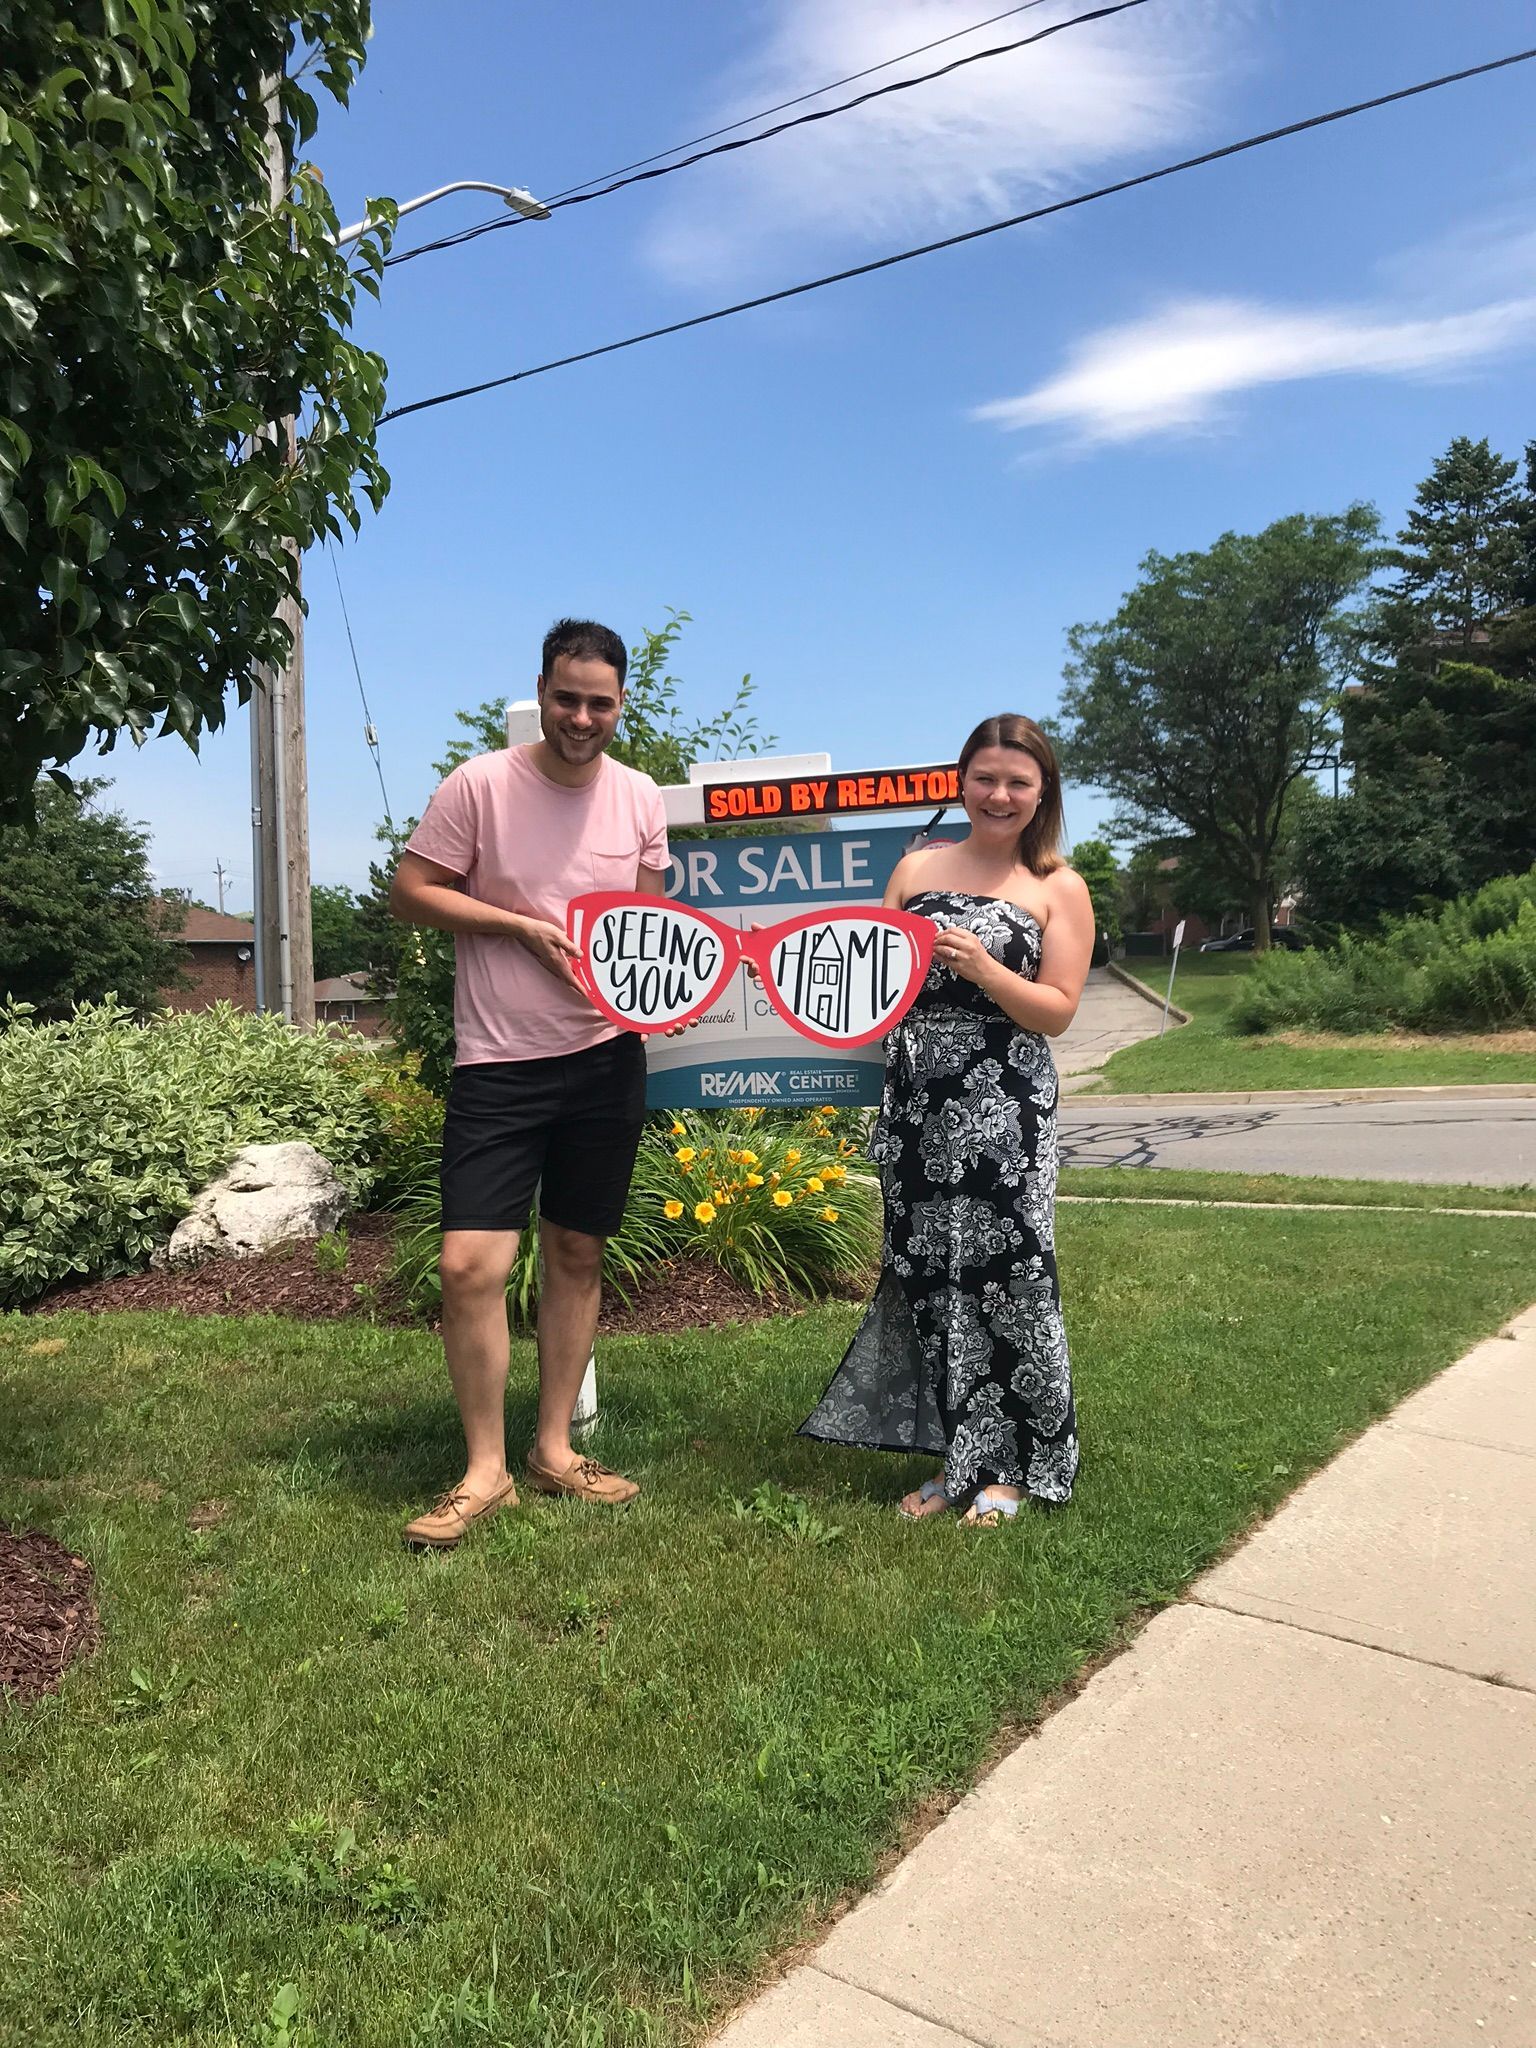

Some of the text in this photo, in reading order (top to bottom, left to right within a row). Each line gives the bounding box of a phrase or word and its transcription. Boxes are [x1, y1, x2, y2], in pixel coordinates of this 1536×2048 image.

[710, 785, 782, 818] SOLD
[791, 782, 828, 811] BY
[738, 840, 874, 895] SALE
[592, 911, 717, 981] SEEING
[754, 999, 779, 1017] Ce
[789, 1074, 855, 1090] CENTRE
